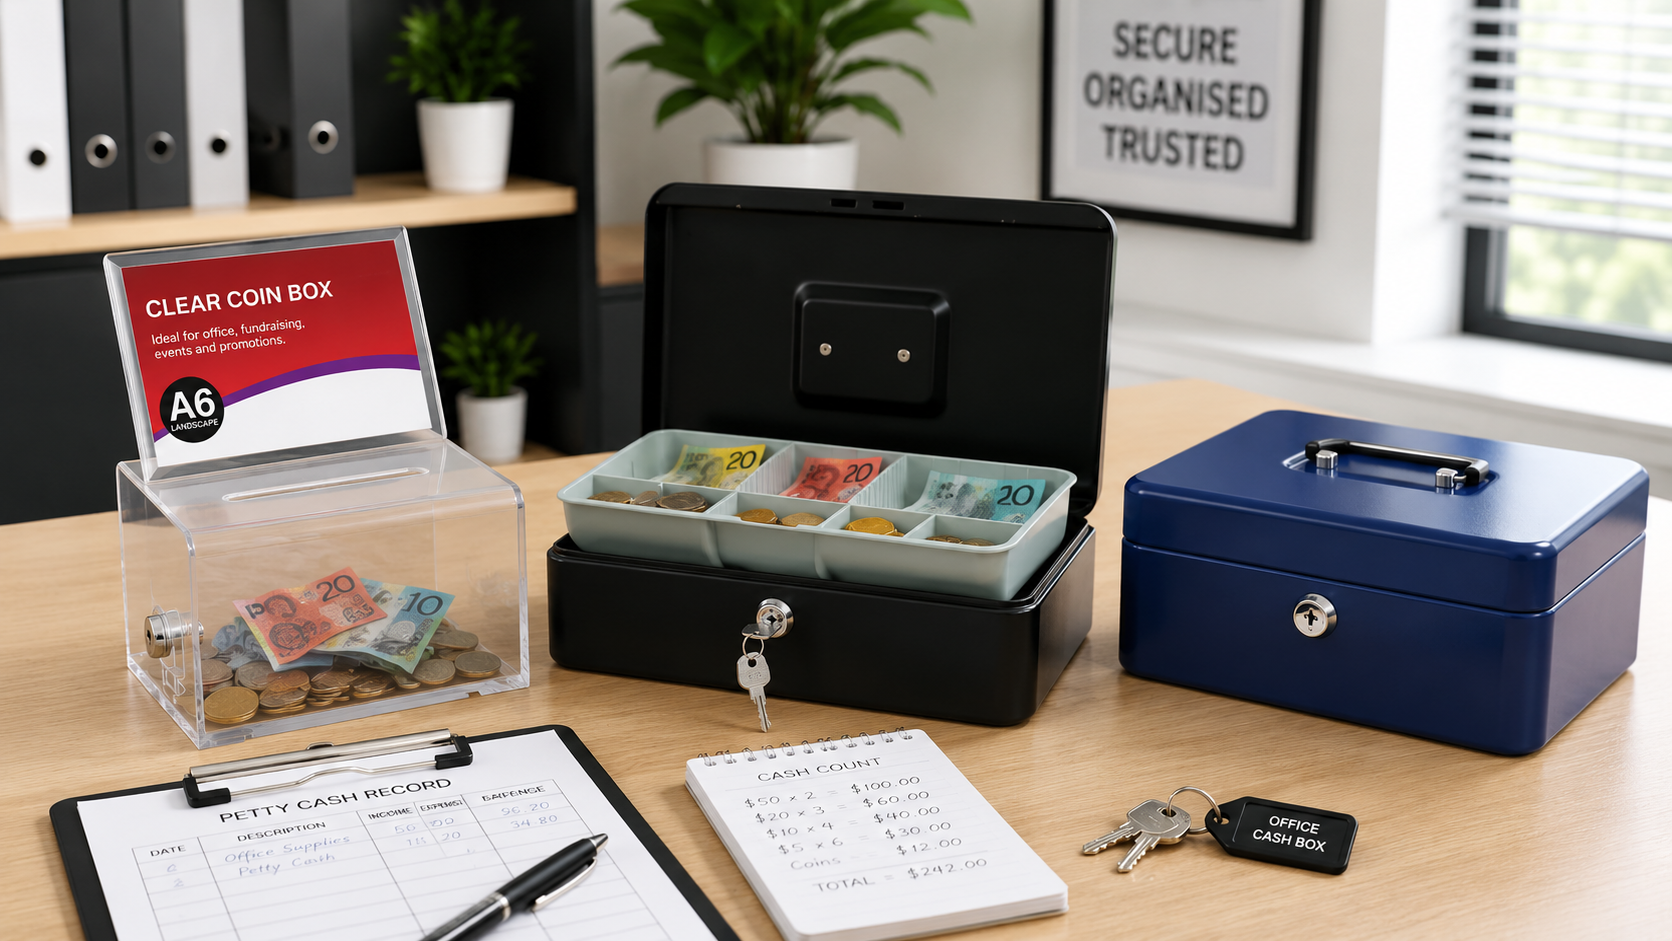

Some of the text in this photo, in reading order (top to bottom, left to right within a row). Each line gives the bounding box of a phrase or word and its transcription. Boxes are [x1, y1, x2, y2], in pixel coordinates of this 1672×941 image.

[1113, 22, 1238, 65] SECURE
[1083, 72, 1270, 121] ORGANISED
[1102, 123, 1245, 172] TRUSTED
[145, 280, 333, 318] CLEAR COIN BOX
[151, 331, 180, 345] Ideal
[183, 331, 200, 341] for
[203, 326, 238, 339] office,
[154, 335, 286, 359] events and promotions.
[171, 387, 216, 422] A6
[171, 418, 219, 431] LANDSCAPE
[726, 450, 757, 470] 20
[843, 463, 873, 483] 20
[997, 484, 1035, 506] 20
[315, 574, 356, 603] 20
[403, 591, 444, 616] 10
[757, 757, 881, 782] CASH COUNT
[219, 778, 451, 823] PETTY CASH RECORD
[744, 796, 780, 808] $50
[804, 791, 816, 800] 2
[851, 776, 920, 794] $100.00
[755, 811, 790, 823] $20
[813, 806, 825, 815] 3
[863, 791, 929, 808] $60.00
[237, 821, 326, 842] DESCRIPTION
[766, 827, 798, 839] $10
[822, 822, 834, 830] 4
[874, 806, 940, 823] $40.00
[1268, 815, 1321, 835] OFFICE
[150, 845, 187, 857] DATE
[224, 836, 350, 864] Office Supplies
[778, 843, 804, 855] $5
[832, 837, 843, 847] 6
[885, 821, 951, 839] $30.00
[1252, 828, 1327, 853] CASH BOX
[790, 857, 841, 870] Coins
[896, 838, 962, 856] $12.00
[238, 863, 281, 877] Petty
[812, 876, 875, 892] TOTAL
[907, 858, 987, 879] $242.00
